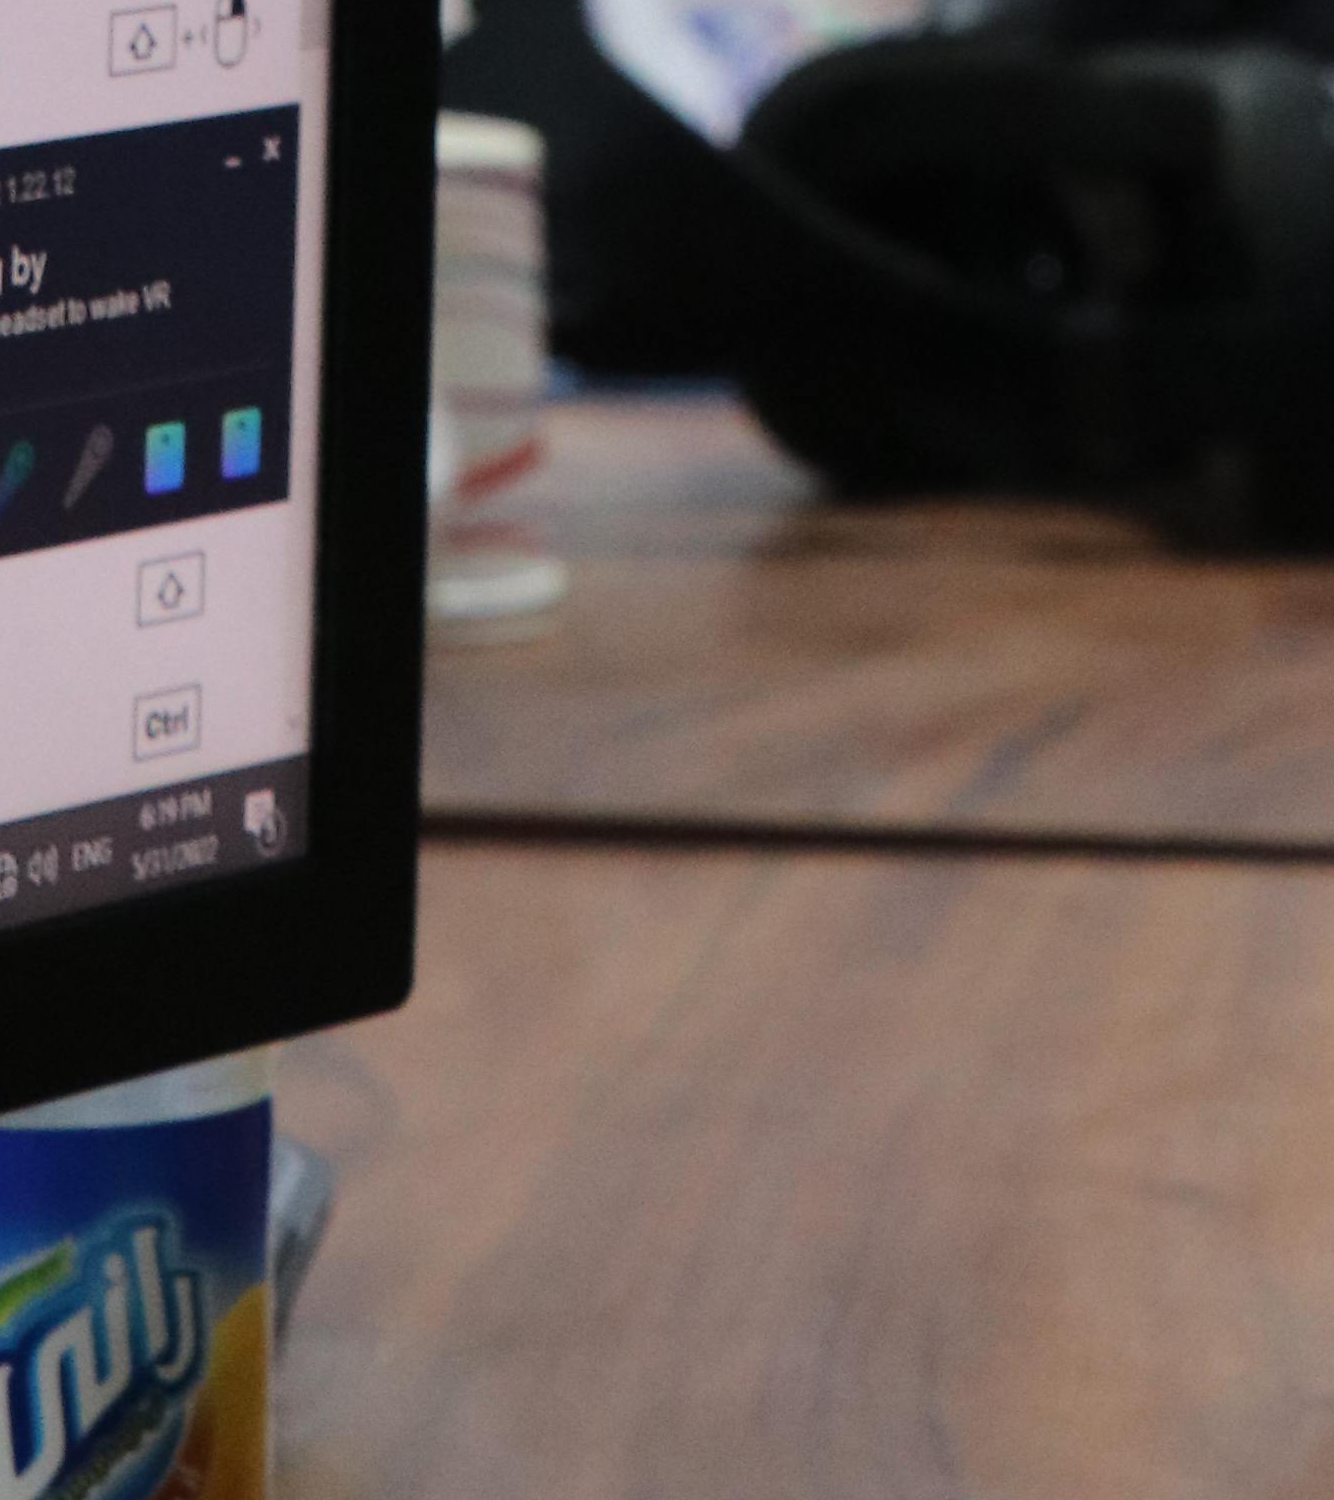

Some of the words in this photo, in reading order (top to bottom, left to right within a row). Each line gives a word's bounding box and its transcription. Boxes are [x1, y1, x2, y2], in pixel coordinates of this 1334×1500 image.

[10, 244, 48, 296] by
[68, 297, 86, 325] to
[89, 288, 140, 321] wake
[142, 279, 171, 311] VR
[145, 706, 189, 740] Ctrl
